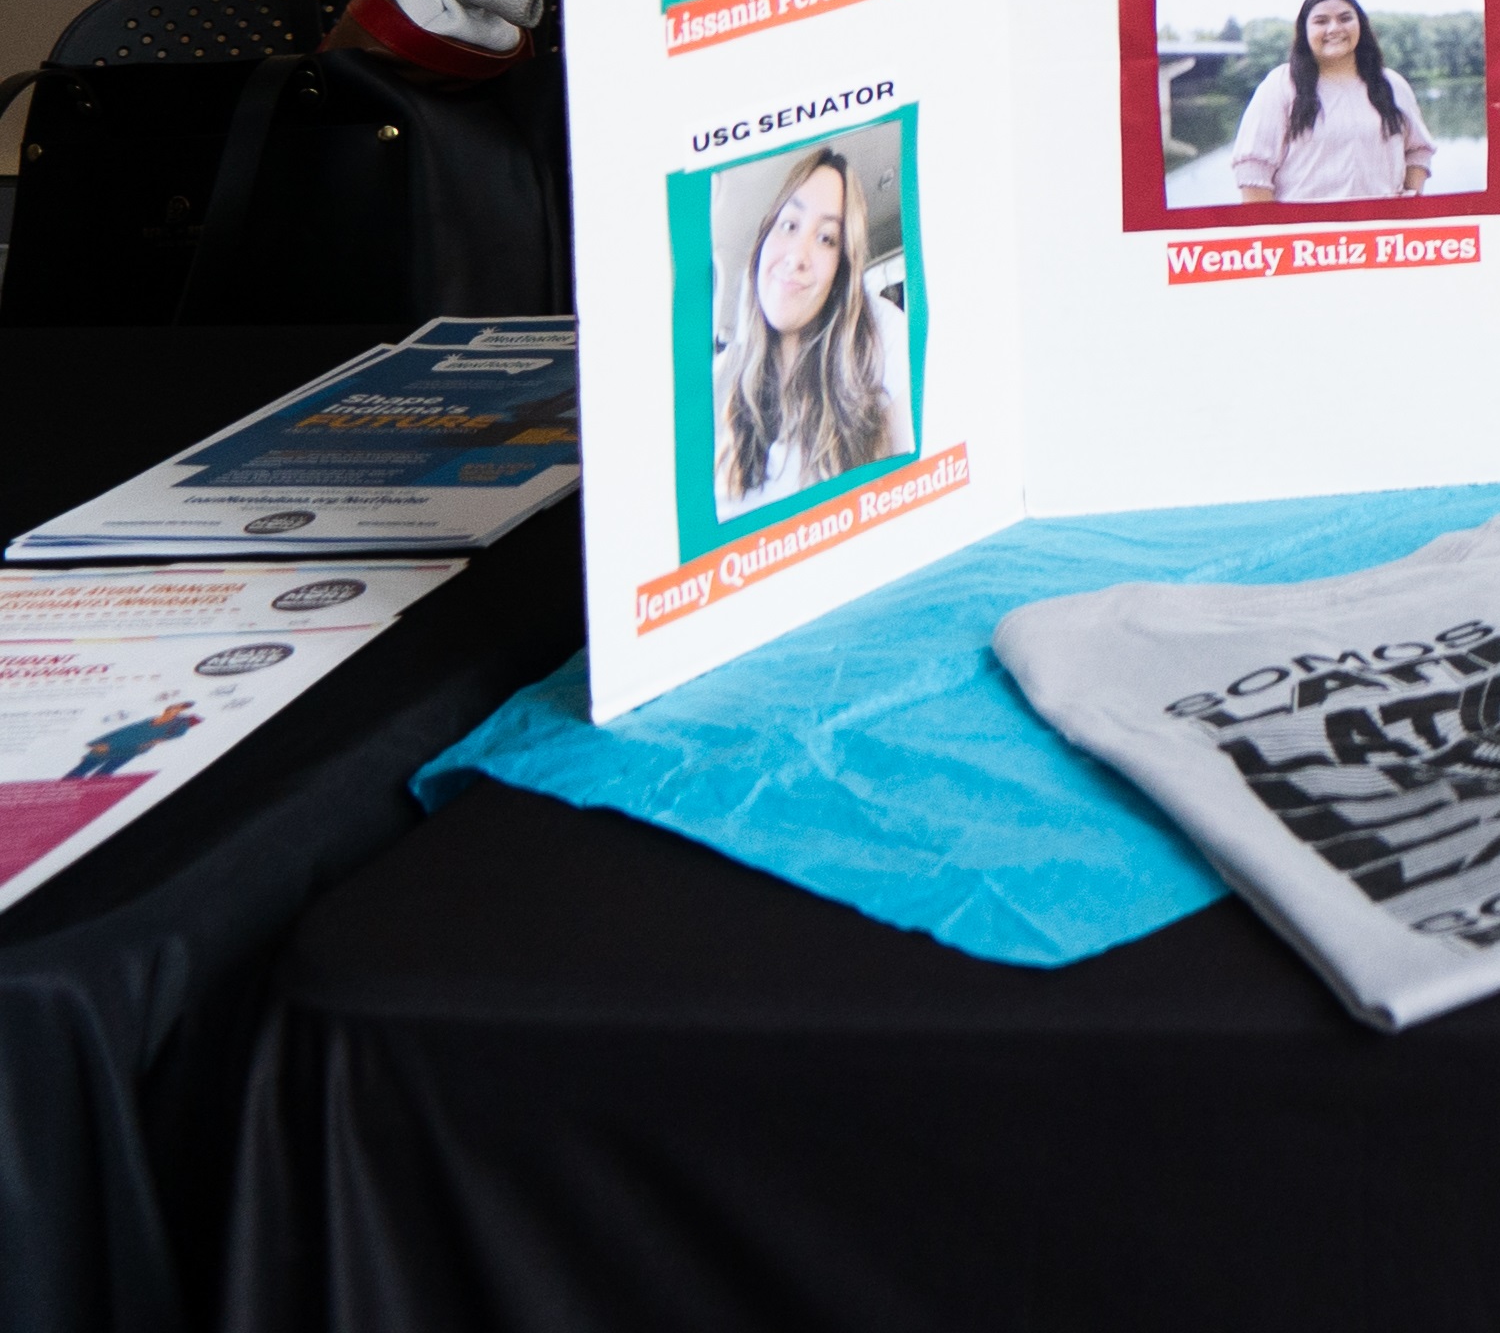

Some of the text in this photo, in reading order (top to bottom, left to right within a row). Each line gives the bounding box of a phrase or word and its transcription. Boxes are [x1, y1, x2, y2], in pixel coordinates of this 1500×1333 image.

[692, 79, 895, 154] USG SENATOR
[1168, 234, 1476, 276] Wendy Ruiz Flores
[321, 404, 471, 414] Indiana's
[342, 394, 445, 405] Shape
[295, 415, 505, 428] FUTURE
[636, 457, 969, 626] Jenny Quinatano Resendiz
[1165, 621, 1492, 717] SOMOS
